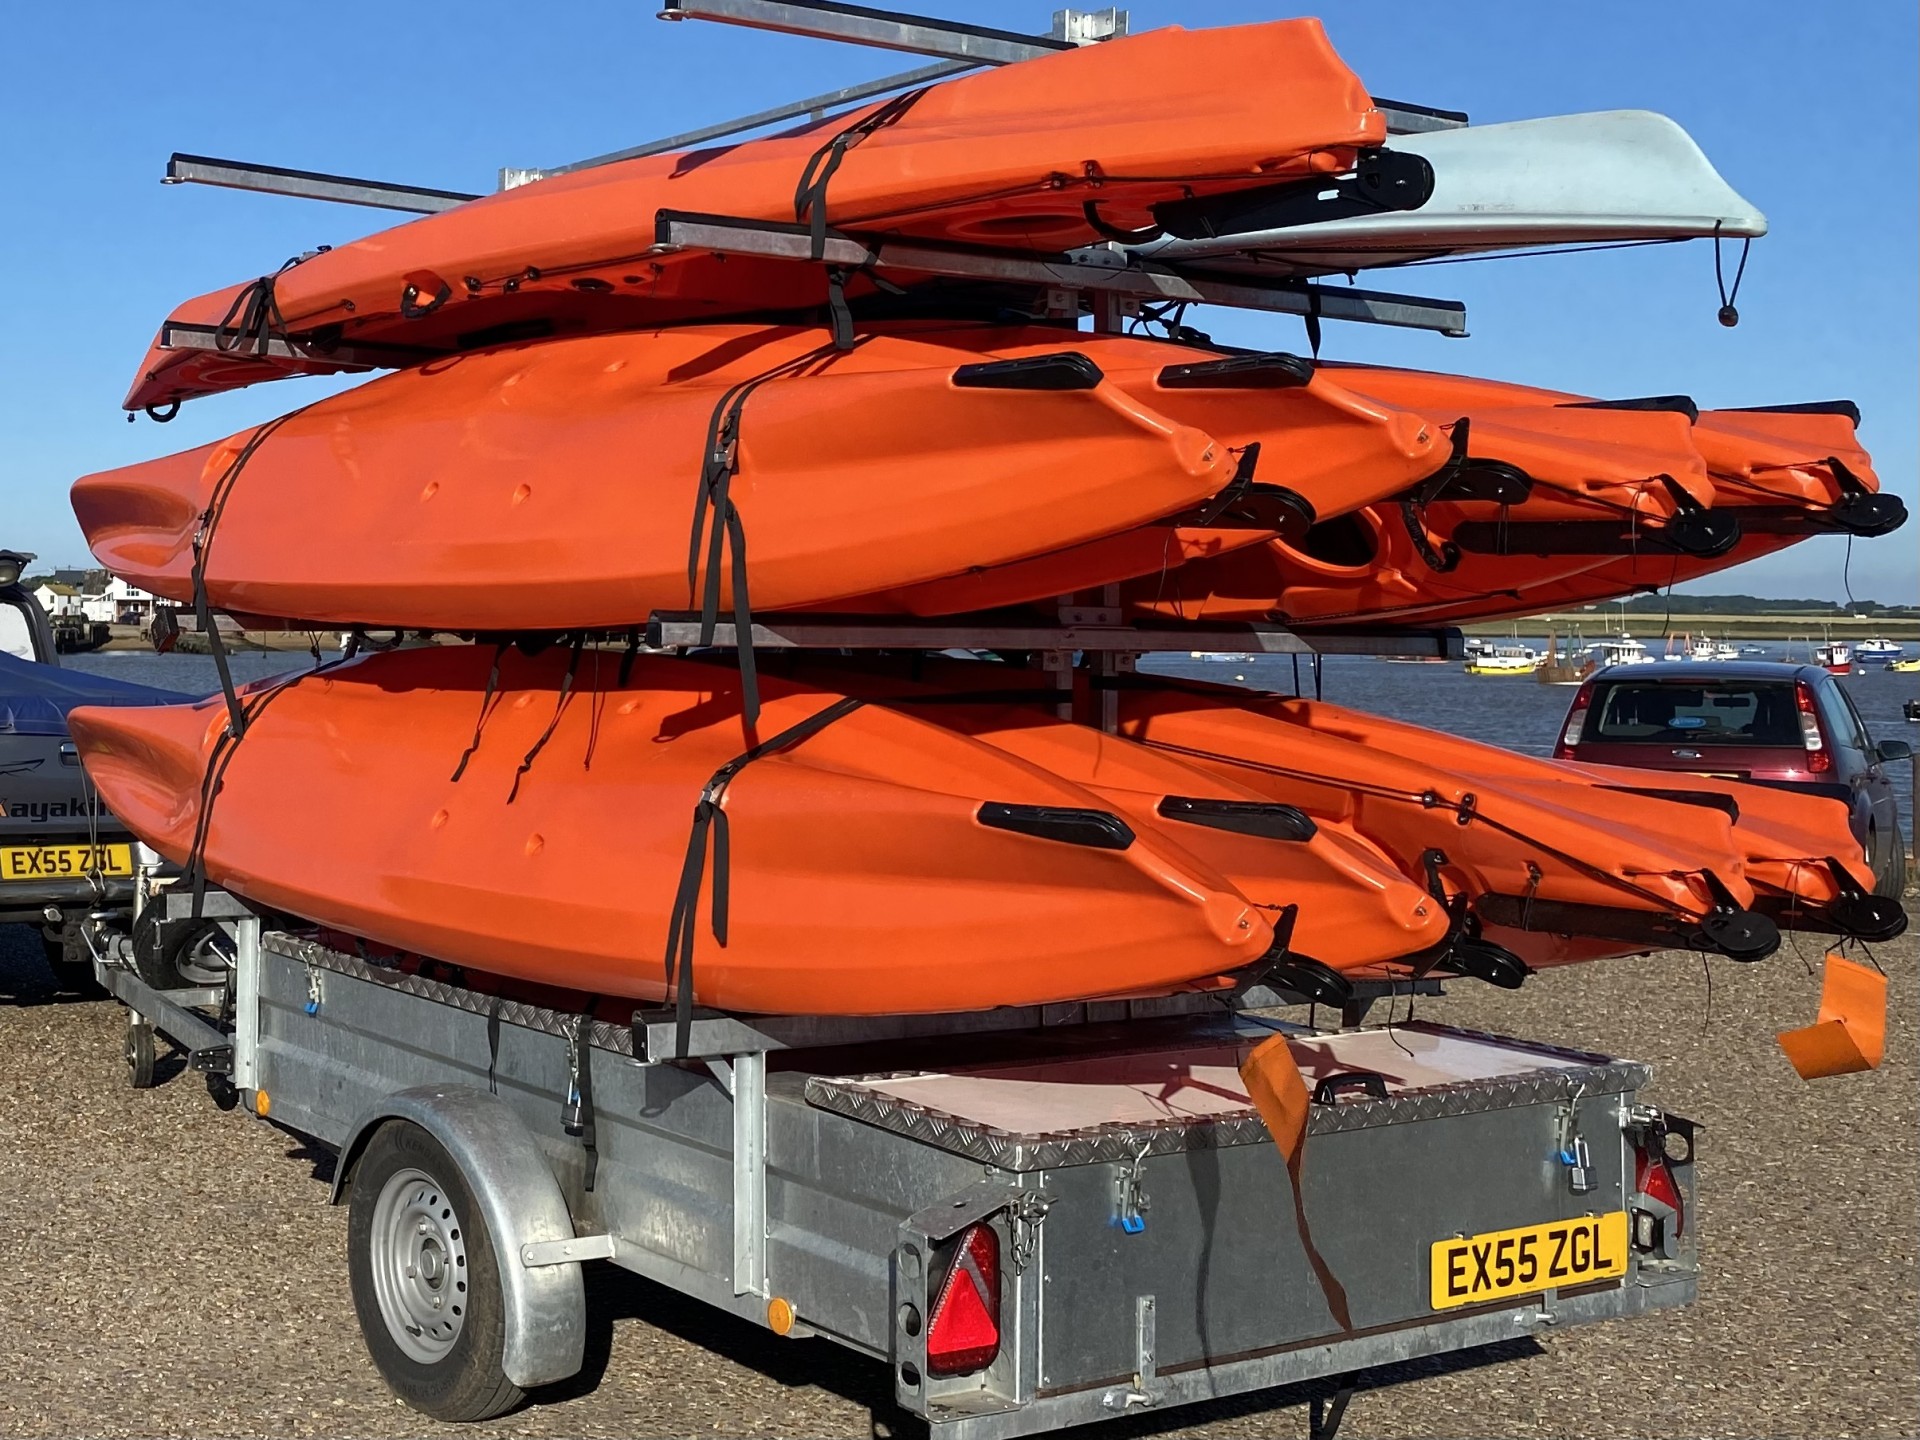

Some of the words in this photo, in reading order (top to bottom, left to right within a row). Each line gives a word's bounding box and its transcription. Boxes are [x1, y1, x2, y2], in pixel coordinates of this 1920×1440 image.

[11, 850, 72, 874] EX55
[1448, 1234, 1538, 1297] EX55
[1549, 1223, 1612, 1278] ZGL
